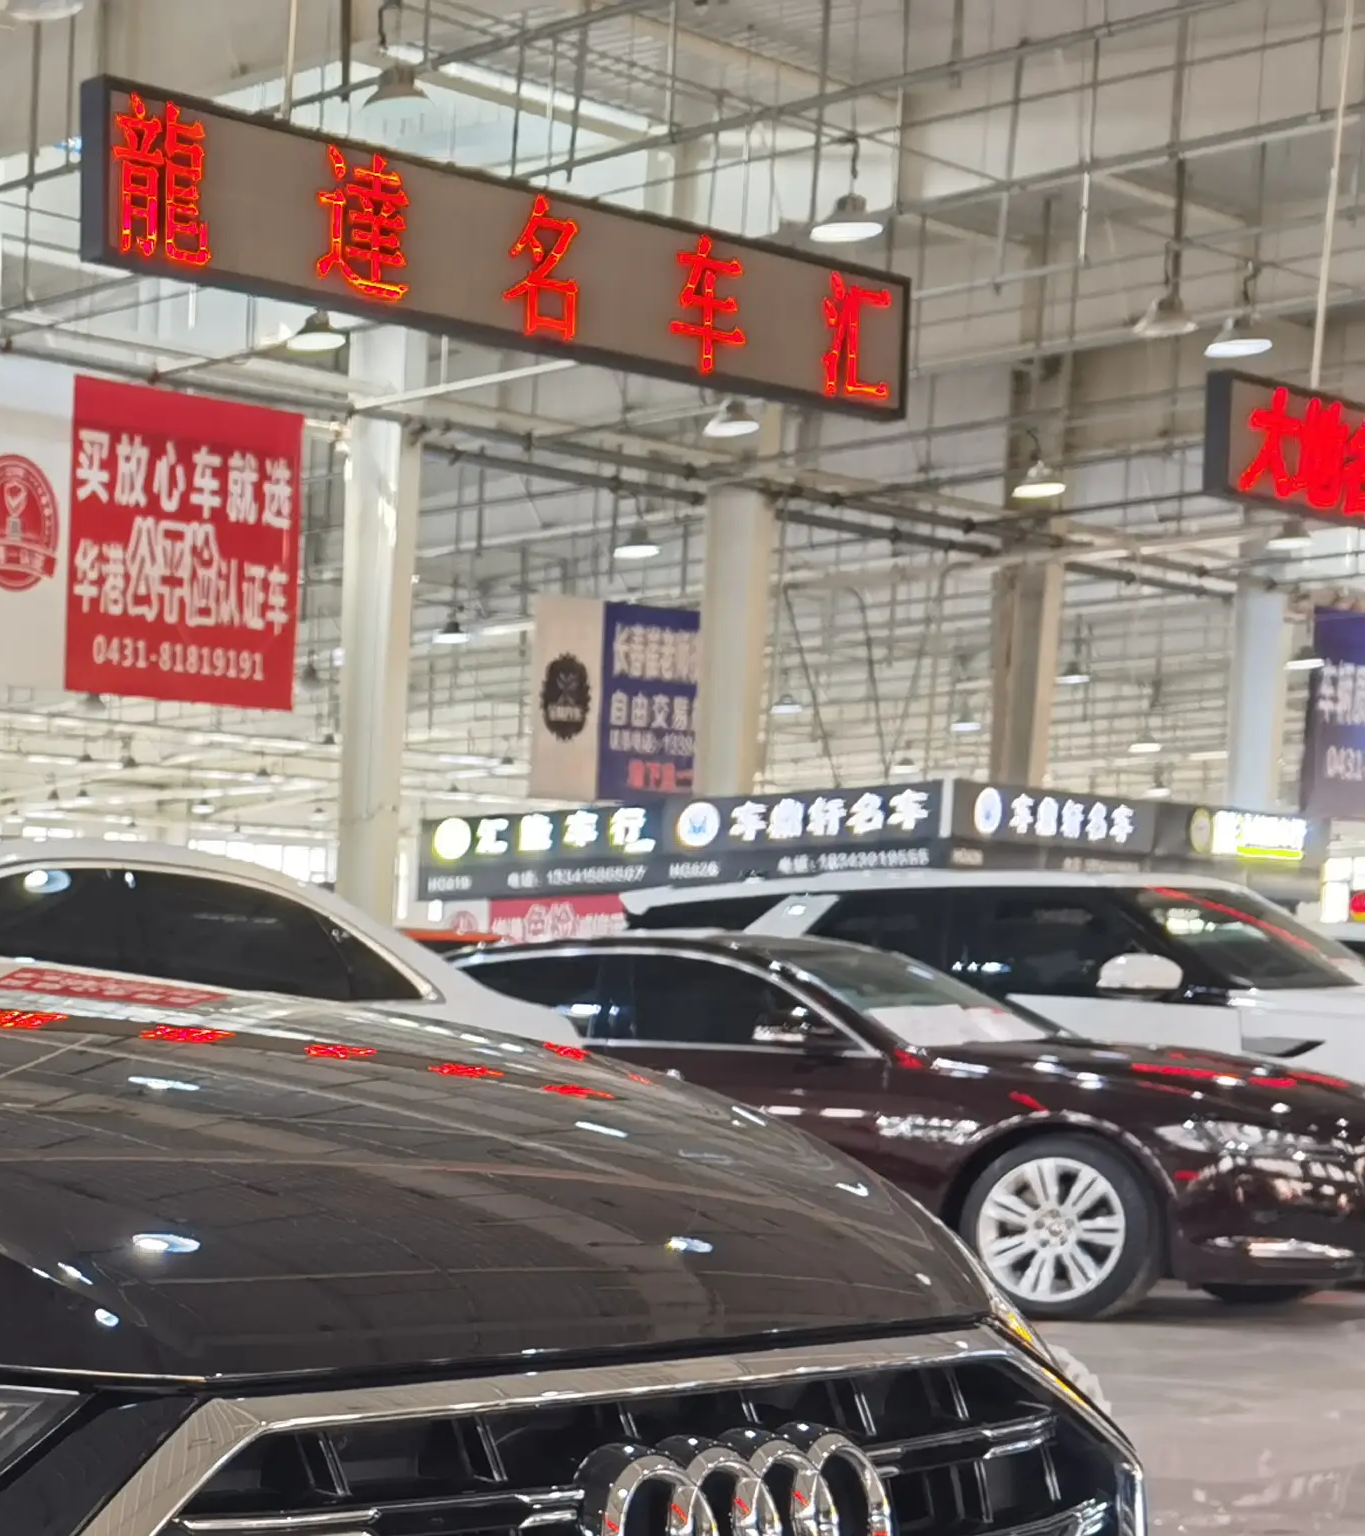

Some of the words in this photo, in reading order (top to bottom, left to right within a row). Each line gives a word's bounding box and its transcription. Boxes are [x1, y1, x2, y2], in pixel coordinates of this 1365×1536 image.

[75, 428, 293, 530] 买放心车就选
[91, 633, 265, 682] 0431-81819191
[609, 688, 696, 732] 自由交易
